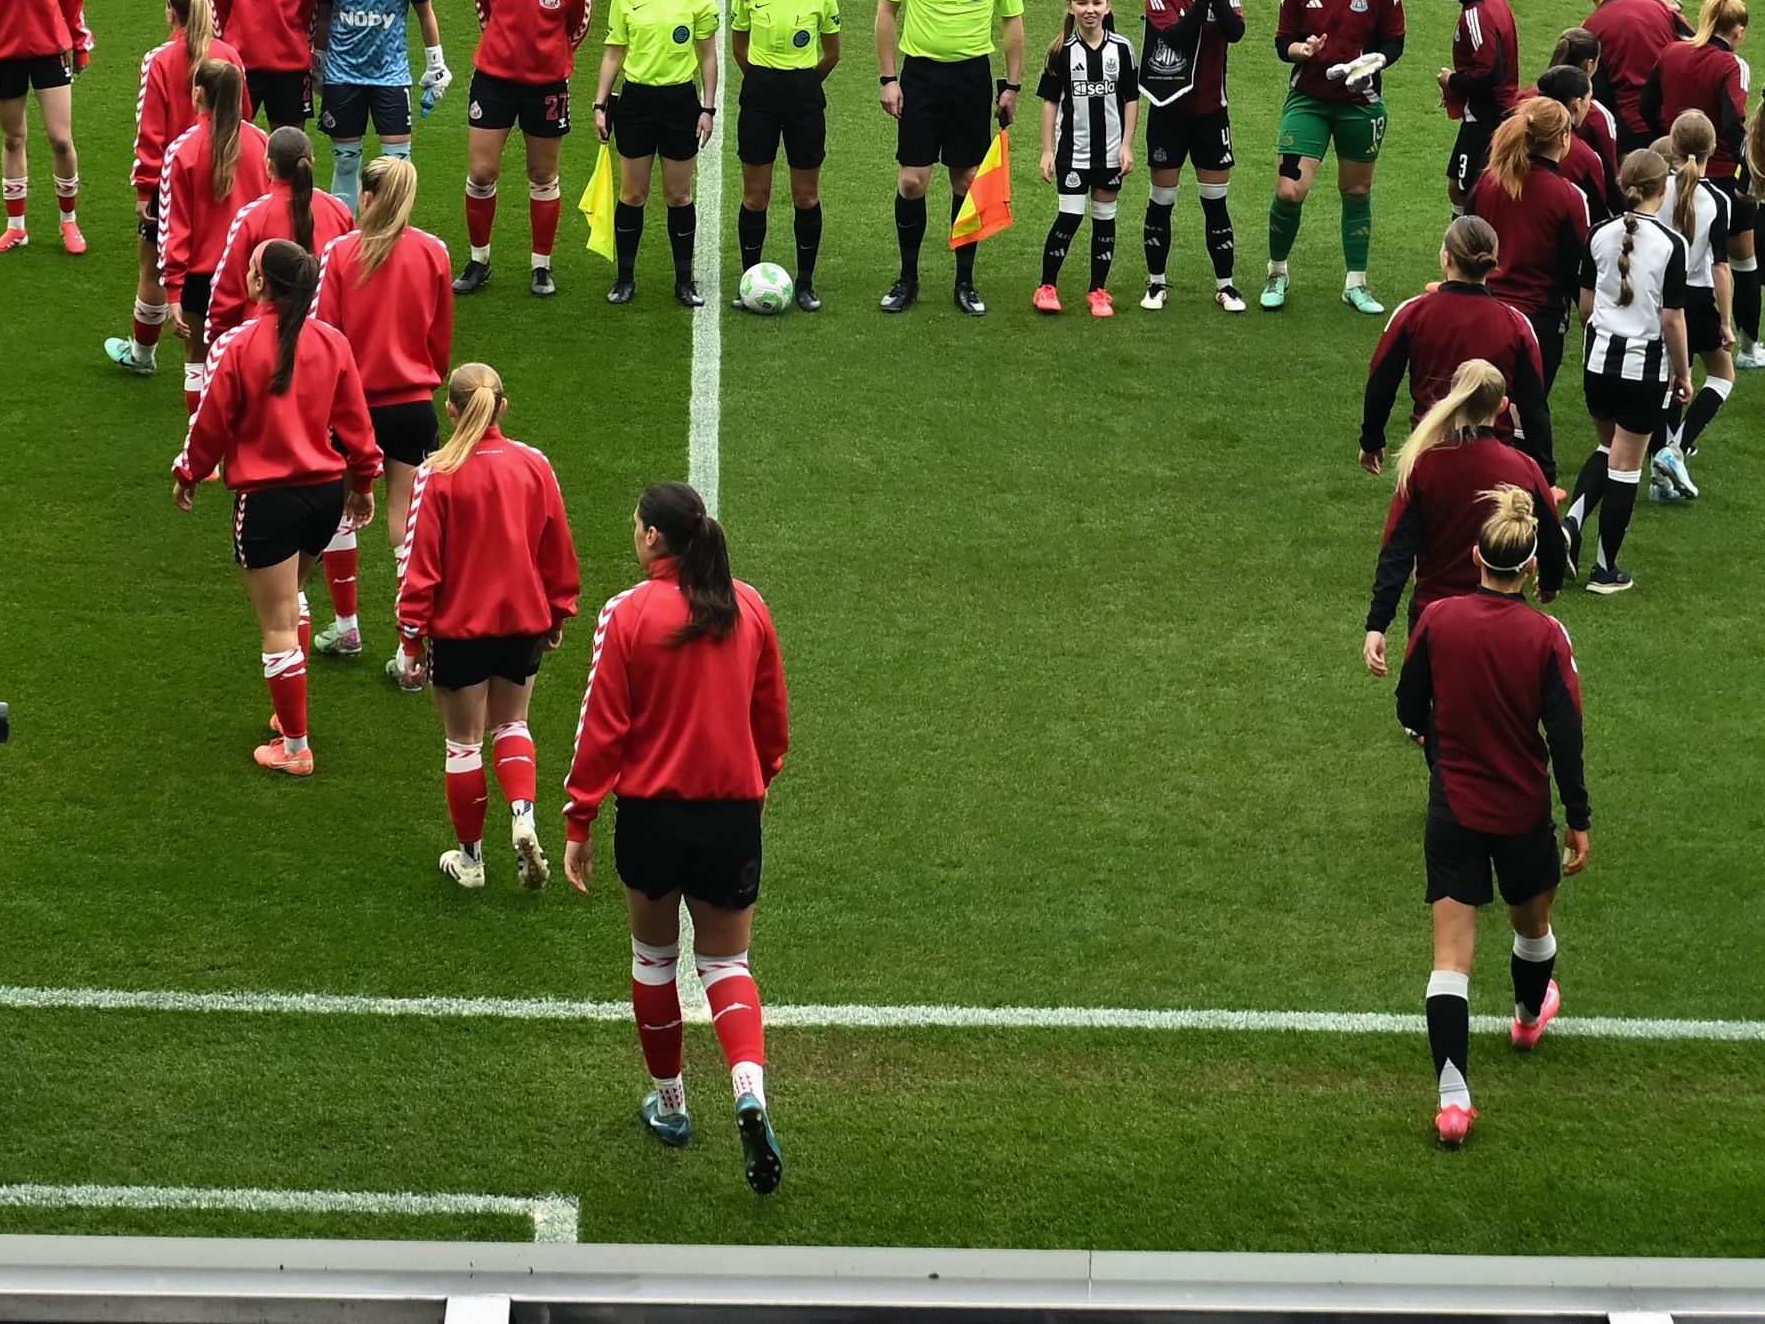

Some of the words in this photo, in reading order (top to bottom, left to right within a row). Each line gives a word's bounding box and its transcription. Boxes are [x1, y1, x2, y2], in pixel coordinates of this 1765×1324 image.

[1087, 80, 1116, 96] sela
[544, 93, 567, 121] 27
[1220, 127, 1231, 150] 4
[1370, 116, 1385, 142] 13
[1458, 153, 1468, 179] 3
